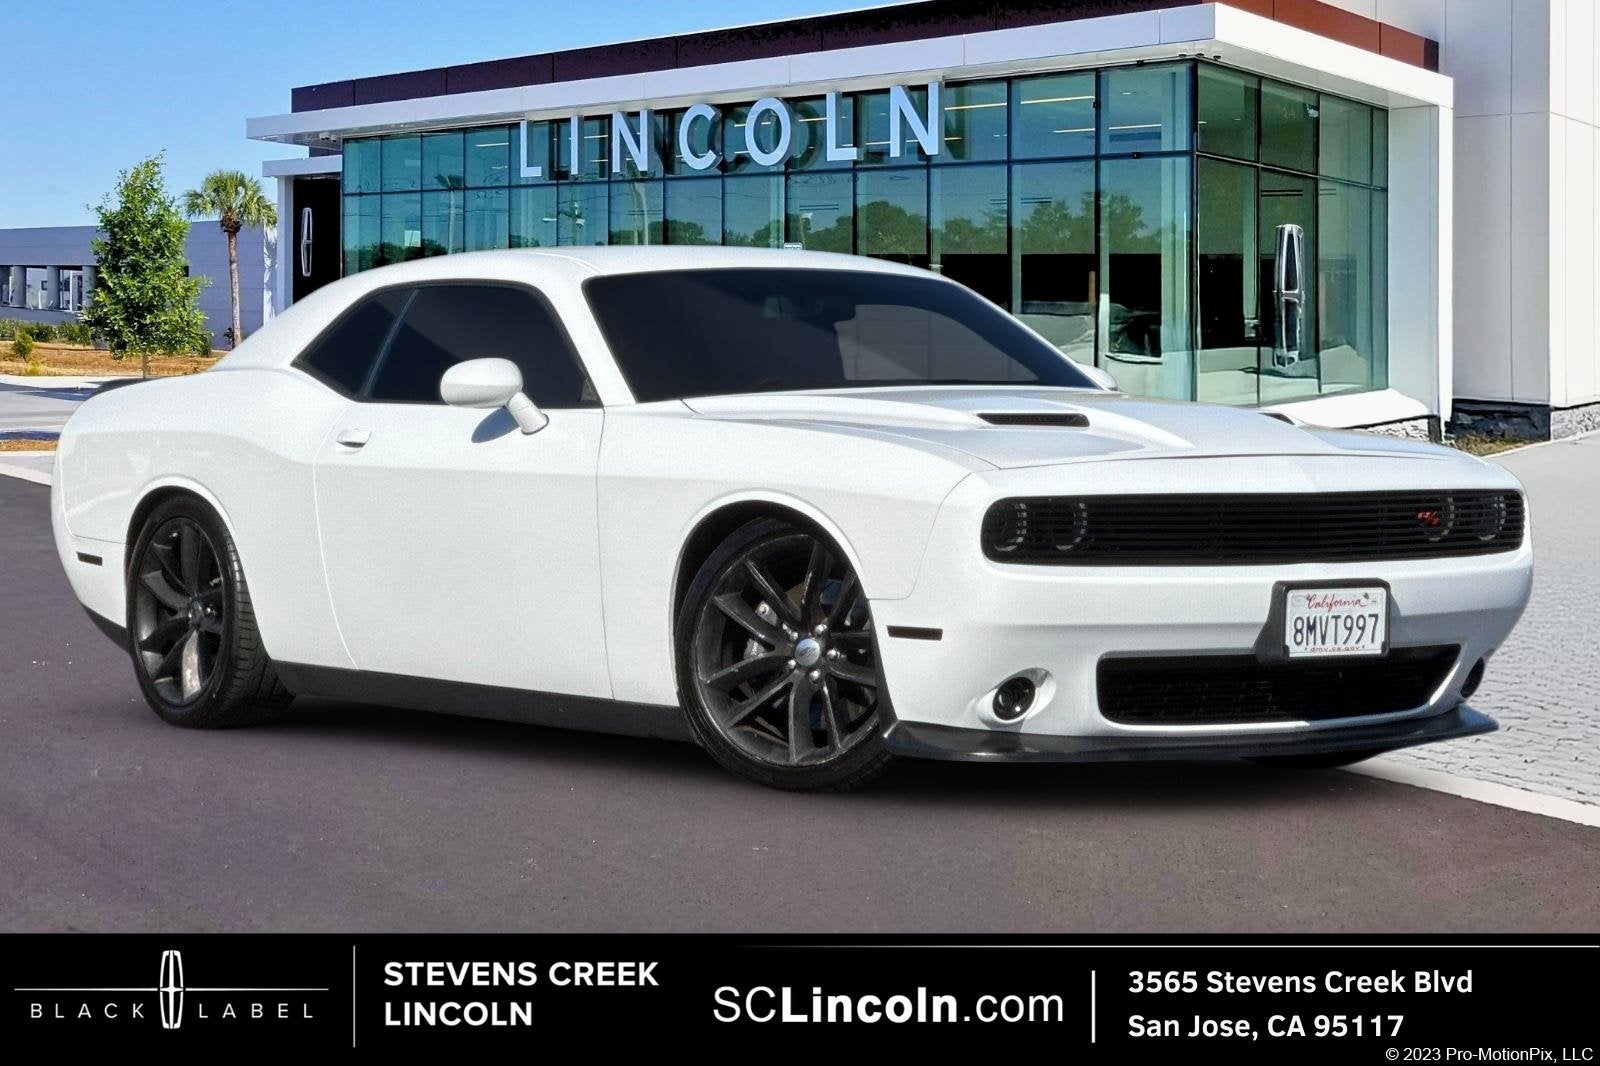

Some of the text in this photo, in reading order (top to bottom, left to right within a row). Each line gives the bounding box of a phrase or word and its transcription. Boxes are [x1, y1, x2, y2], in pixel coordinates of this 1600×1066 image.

[520, 82, 939, 178] LINCOLN
[1307, 593, 1368, 613] California
[1294, 614, 1379, 646] 8MVT997
